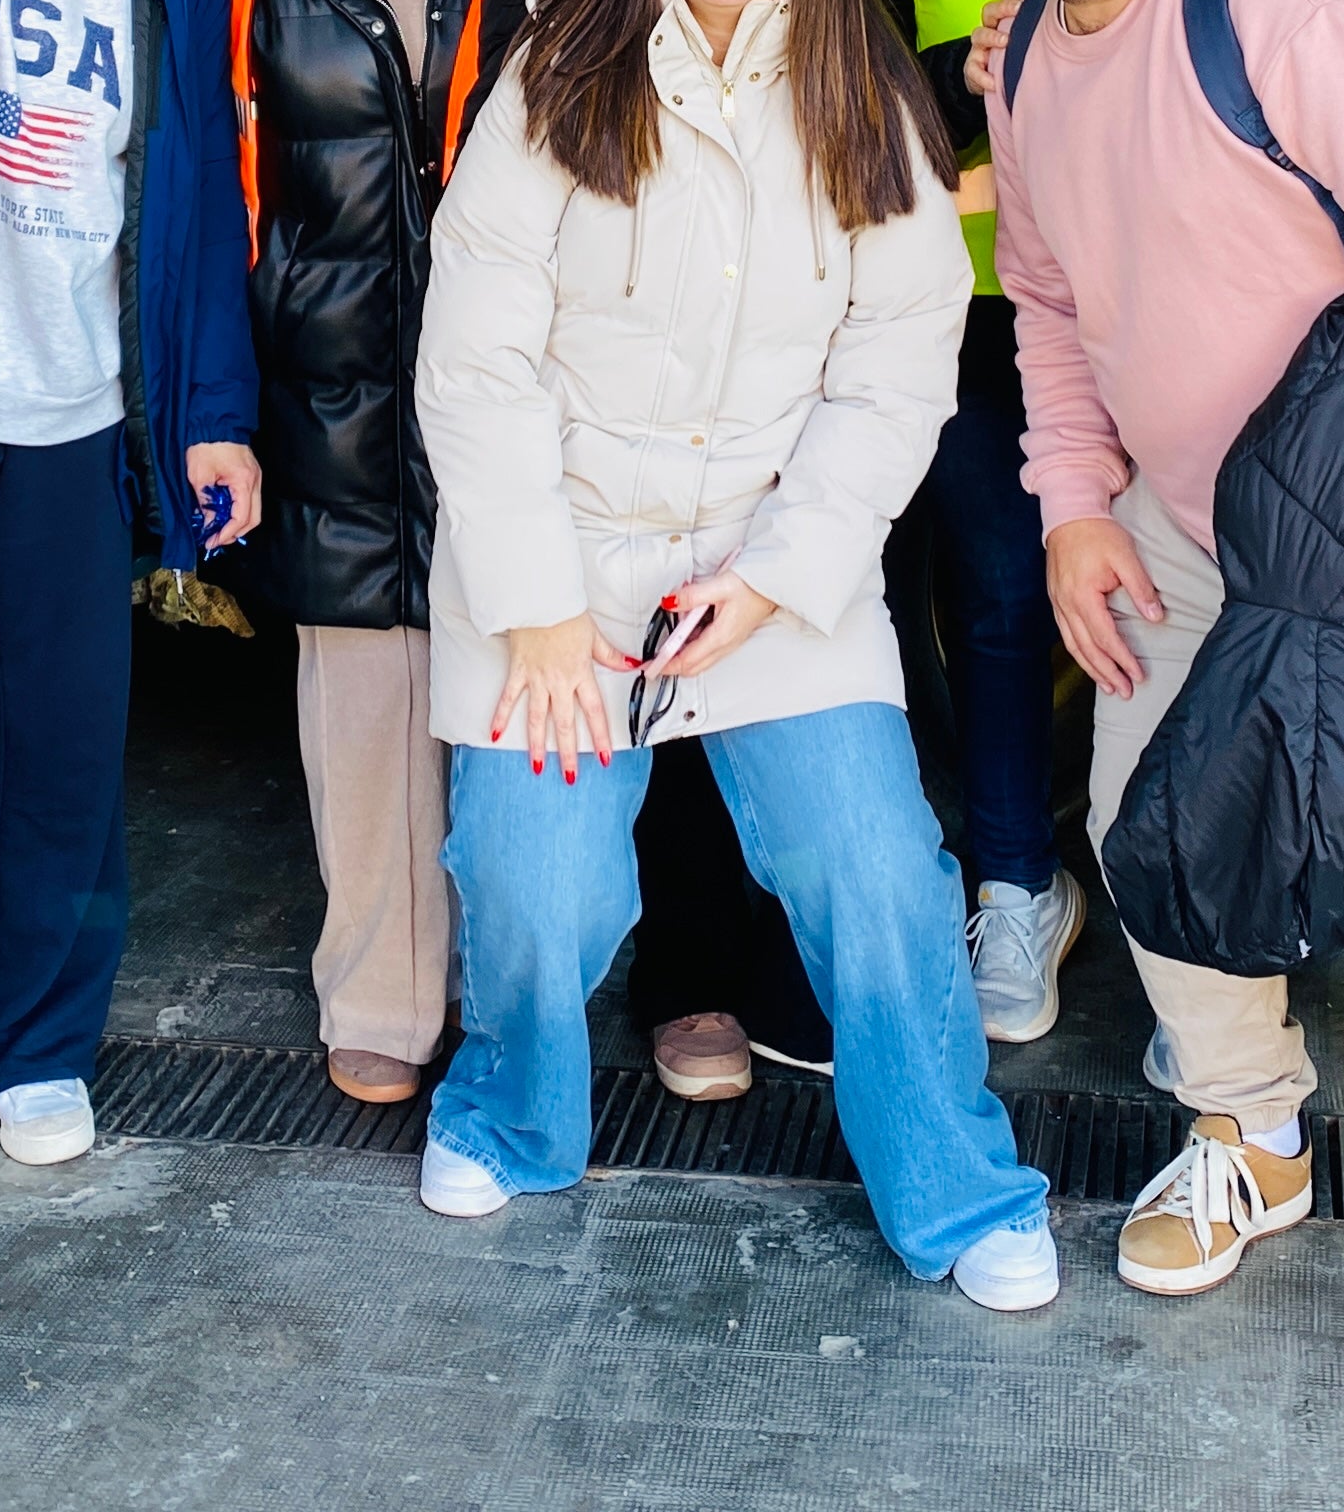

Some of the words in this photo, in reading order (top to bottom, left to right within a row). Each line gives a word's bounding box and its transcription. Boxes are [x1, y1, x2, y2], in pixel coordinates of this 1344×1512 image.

[0, 194, 28, 219] YORK
[34, 207, 65, 225] STATE
[12, 219, 50, 237] ALBANY
